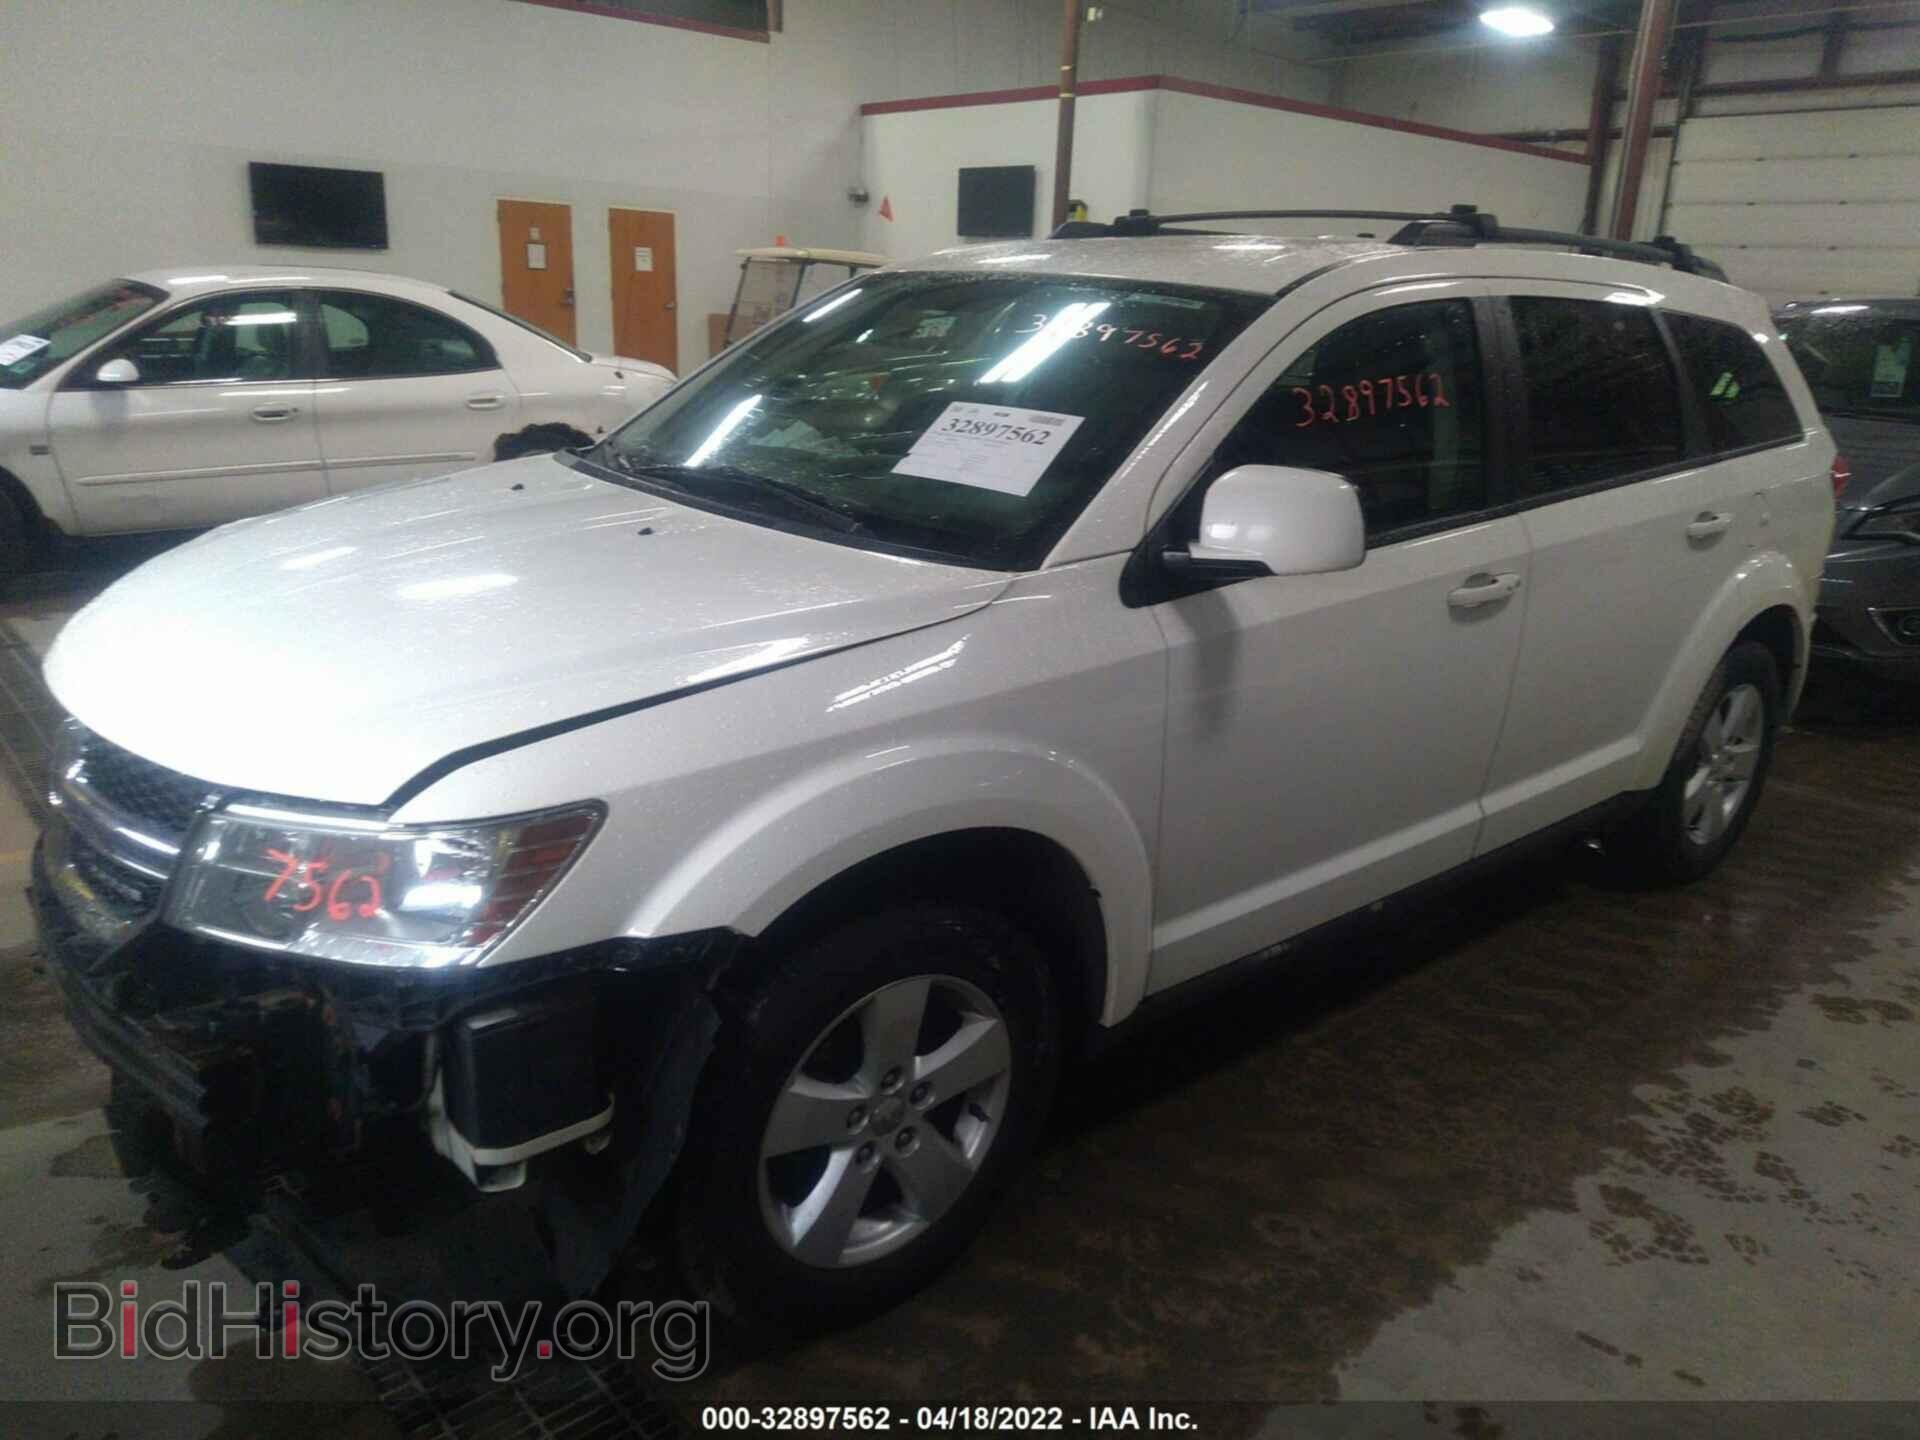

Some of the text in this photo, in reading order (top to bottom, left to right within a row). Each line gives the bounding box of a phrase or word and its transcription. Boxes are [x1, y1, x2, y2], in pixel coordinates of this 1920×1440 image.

[1016, 313, 1204, 360] 3897562
[1292, 373, 1451, 428] 32897562
[941, 417, 1052, 446] 32897562
[262, 847, 384, 922] 7562
